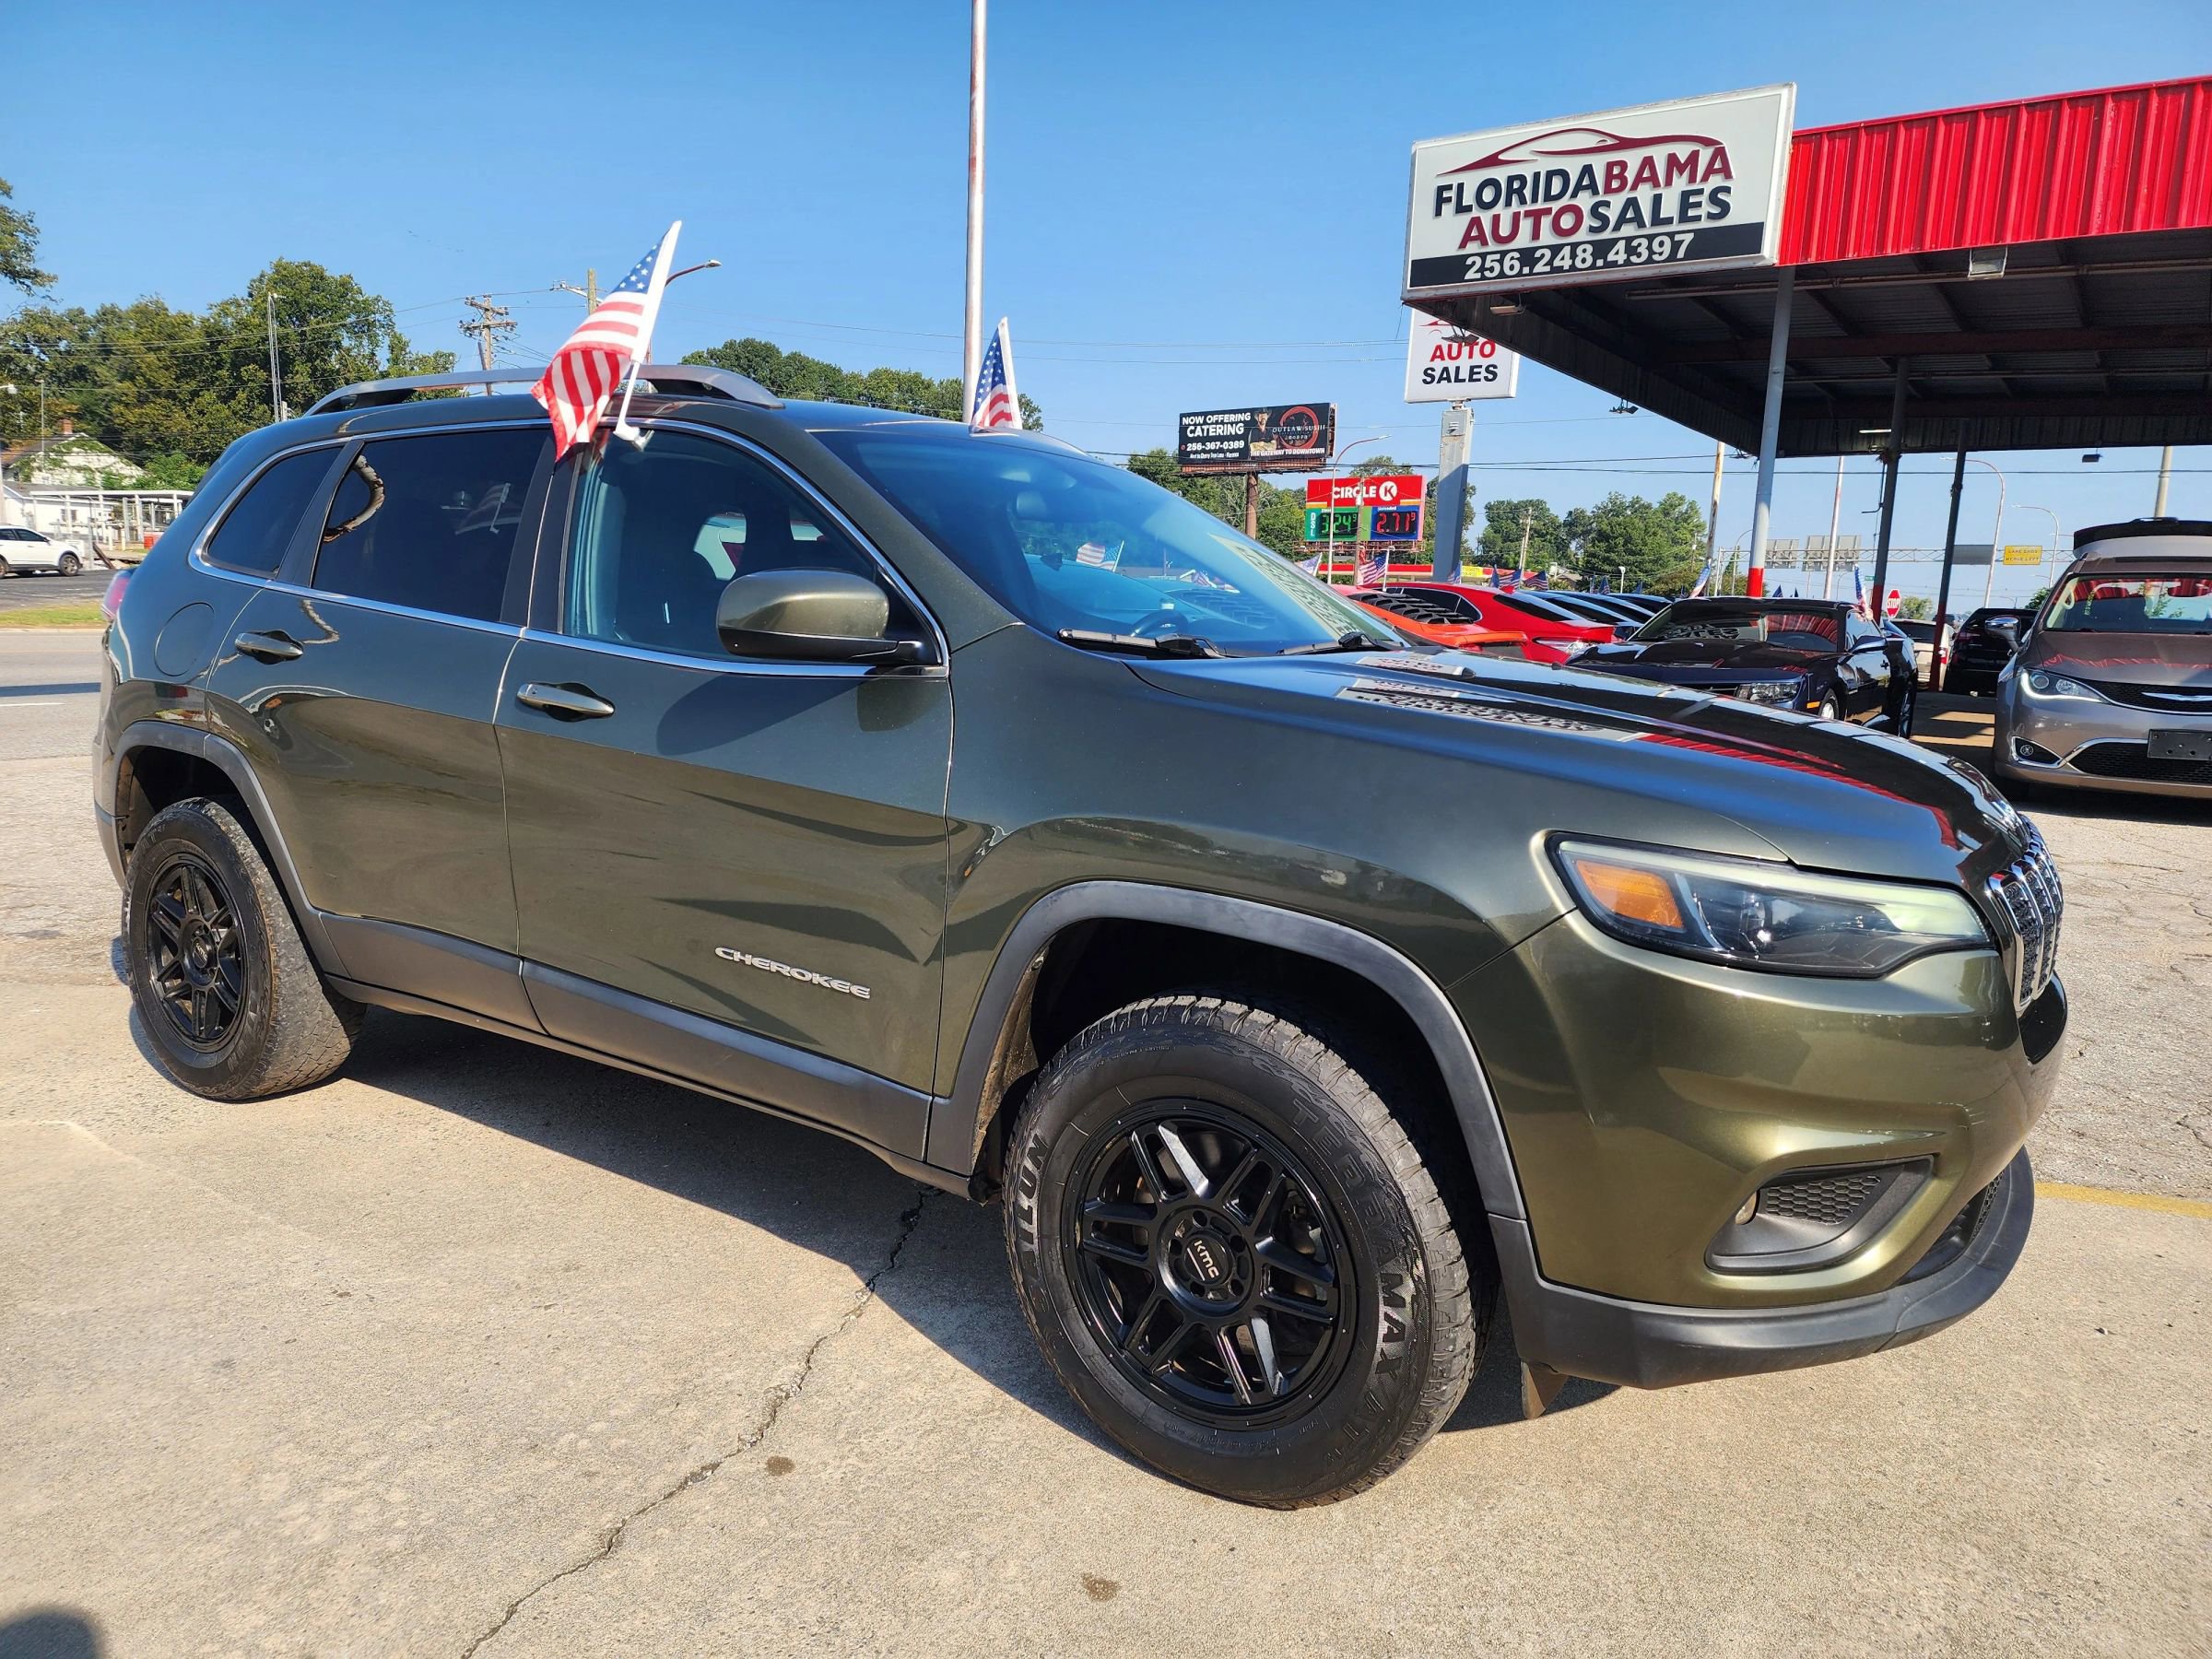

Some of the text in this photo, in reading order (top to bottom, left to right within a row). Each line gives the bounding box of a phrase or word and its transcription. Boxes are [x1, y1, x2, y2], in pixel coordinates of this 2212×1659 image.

[1464, 232, 1695, 280] 256.248.4397
[1430, 338, 1497, 363] AUTO
[1421, 363, 1499, 385] SALES
[1182, 412, 1252, 426] NOW OFFERING
[1186, 422, 1244, 437] CATERING
[1293, 447, 1325, 455] DOWNTOWN
[1333, 486, 1377, 499] CIRCLE
[1887, 598, 1900, 608] STOP
[714, 947, 871, 1000] CHEROKEE
